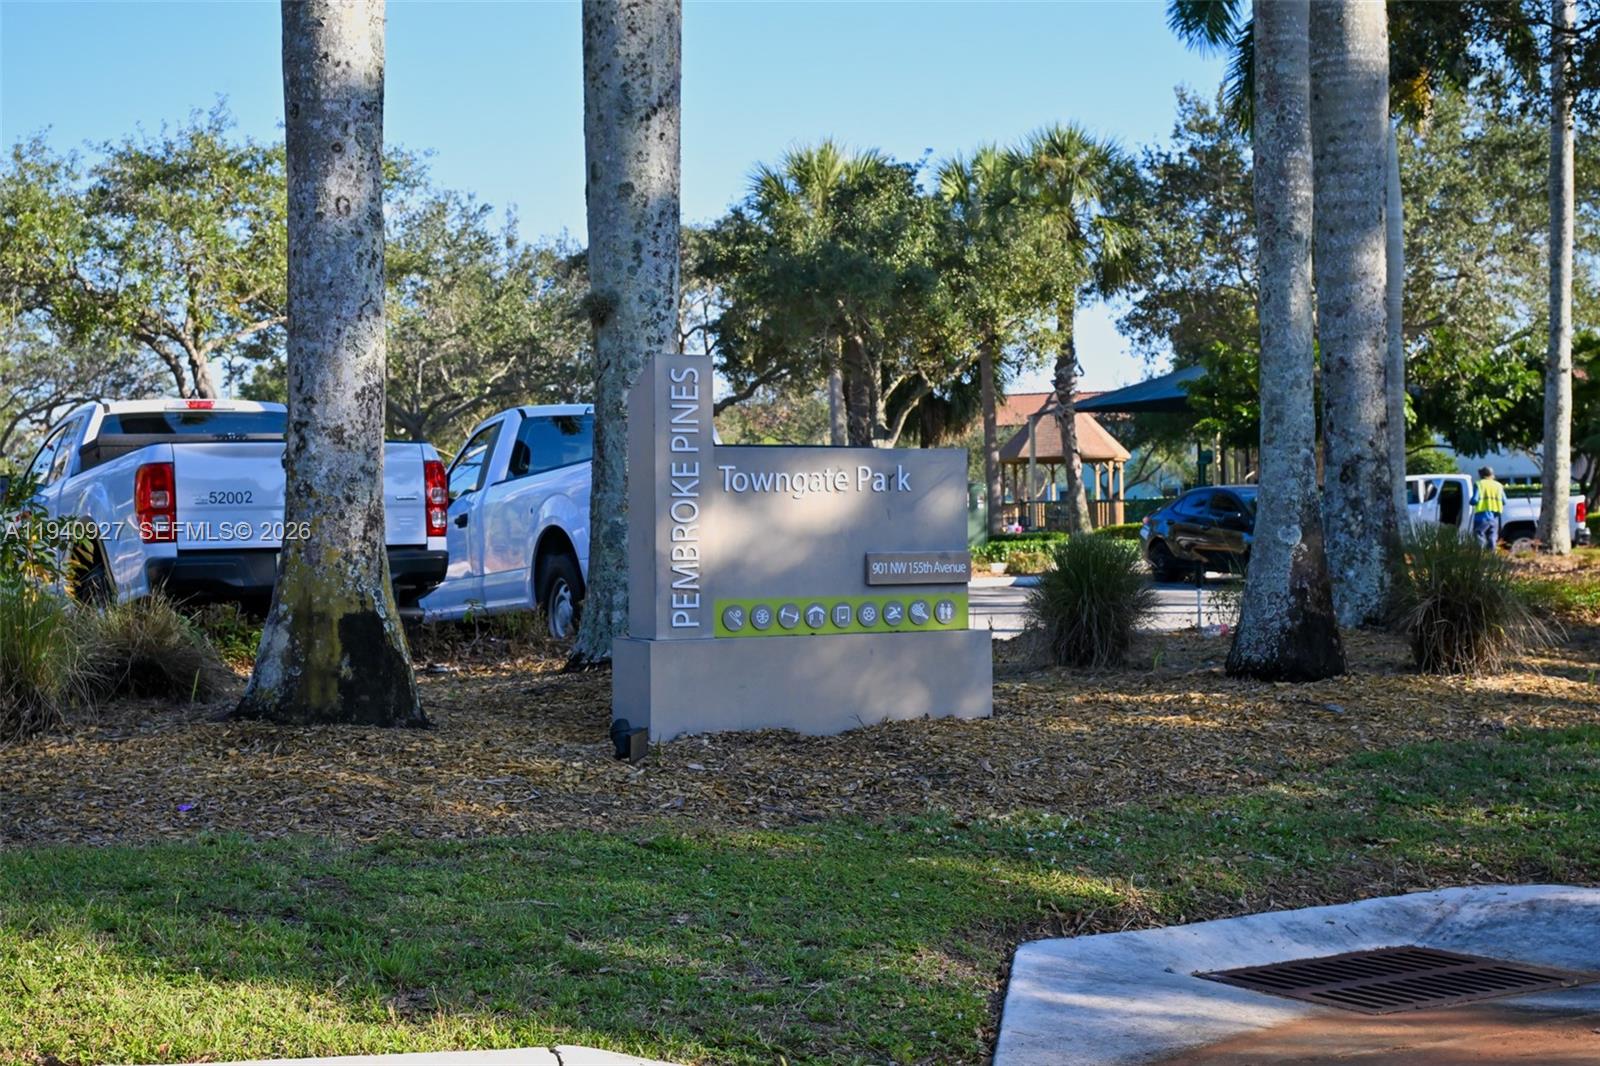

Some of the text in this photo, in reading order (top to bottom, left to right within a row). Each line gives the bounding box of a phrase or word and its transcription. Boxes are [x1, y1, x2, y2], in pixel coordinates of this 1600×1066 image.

[718, 464, 911, 500] Towngate Park
[208, 490, 253, 505] 52002
[671, 367, 700, 628] PEMBROKE PINES
[872, 561, 967, 575] 901 NW 155th Avenue
